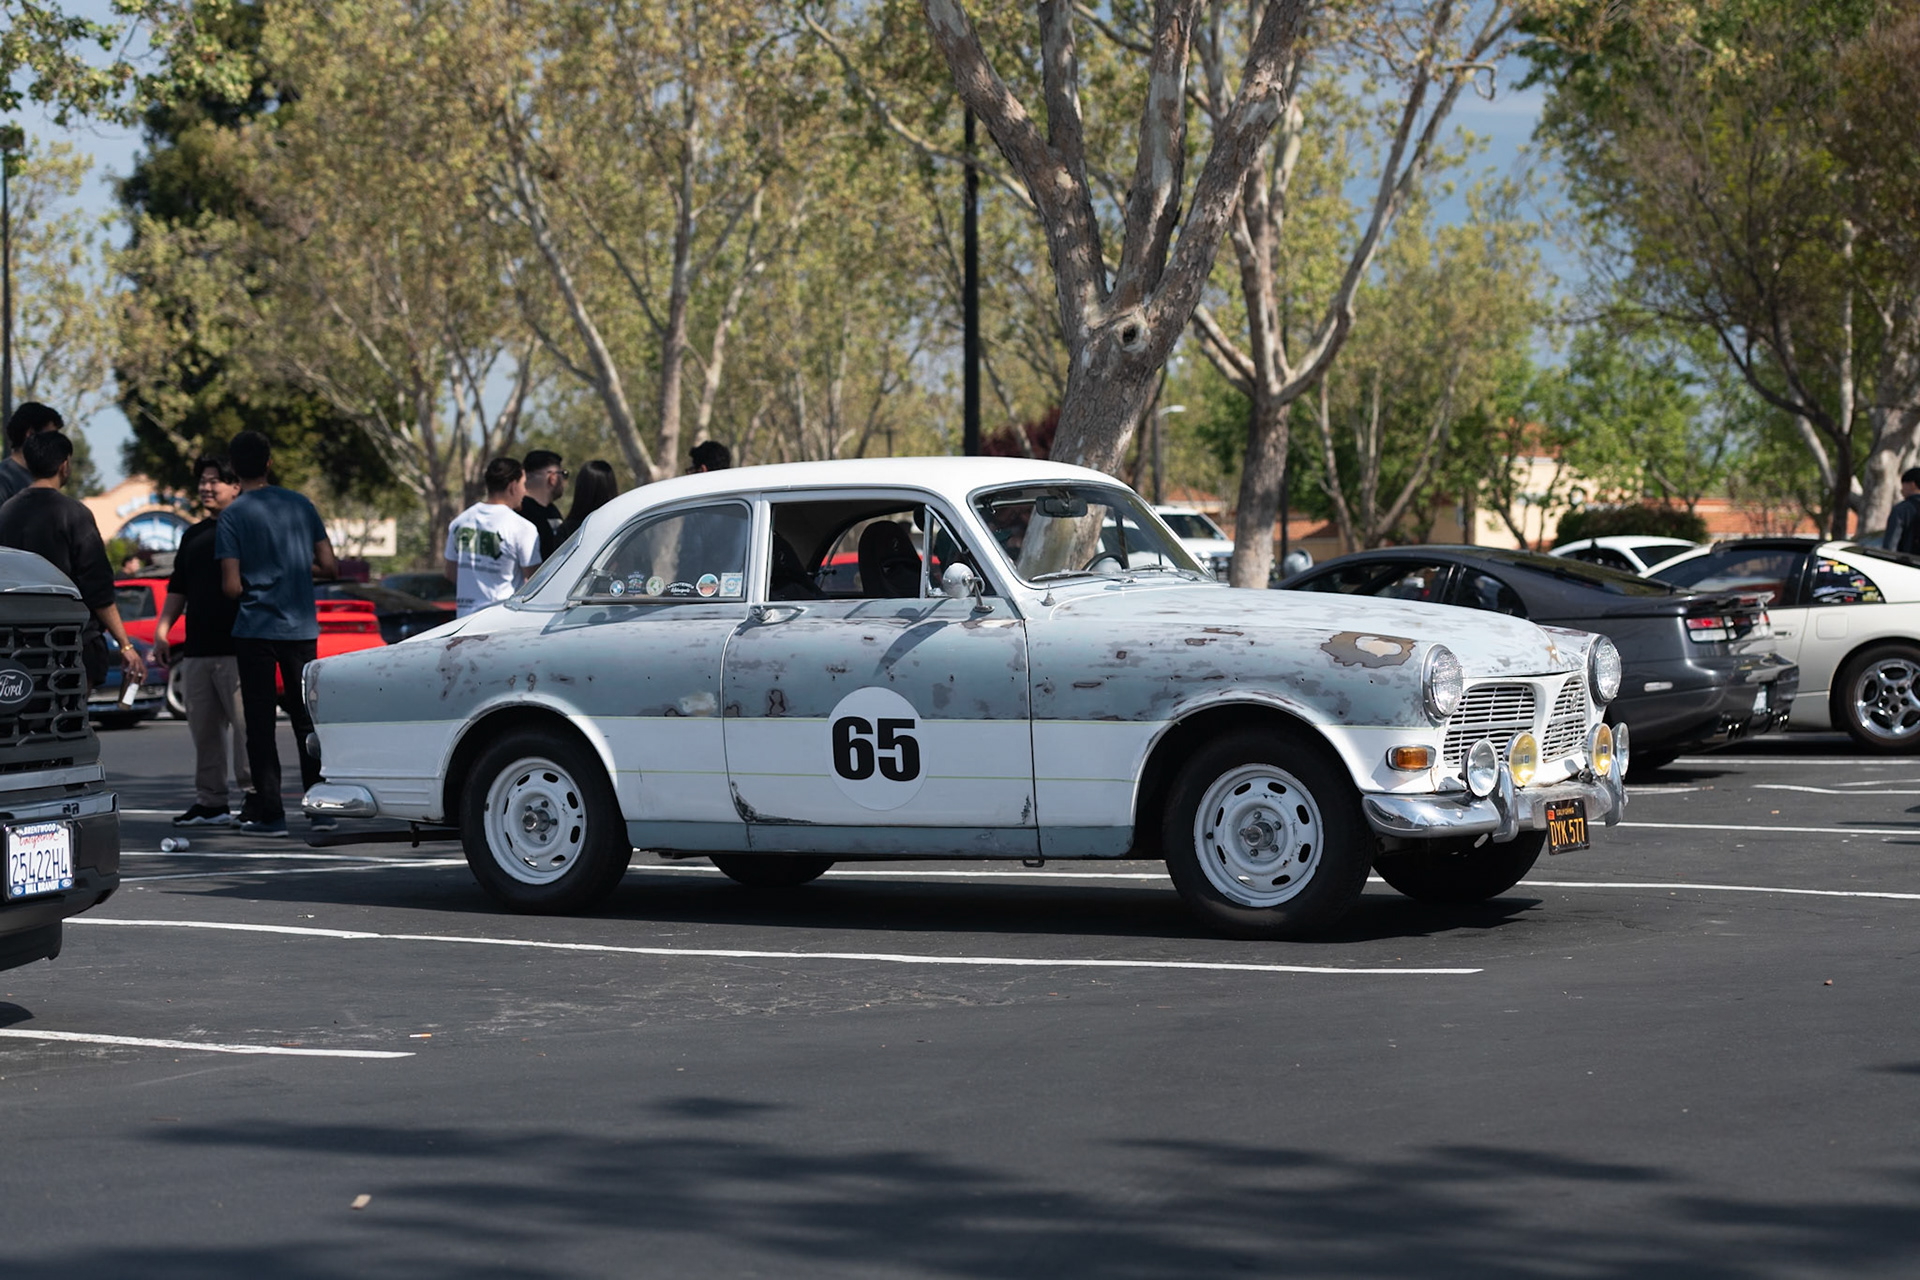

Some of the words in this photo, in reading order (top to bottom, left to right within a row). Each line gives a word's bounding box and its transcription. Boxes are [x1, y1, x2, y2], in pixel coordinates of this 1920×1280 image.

[0, 675, 23, 697] Ford
[832, 716, 920, 782] 65
[24, 823, 57, 833] BRENTWOOD
[1550, 821, 1569, 846] DYK
[1568, 818, 1585, 843] 577
[12, 847, 68, 885] 25422H4
